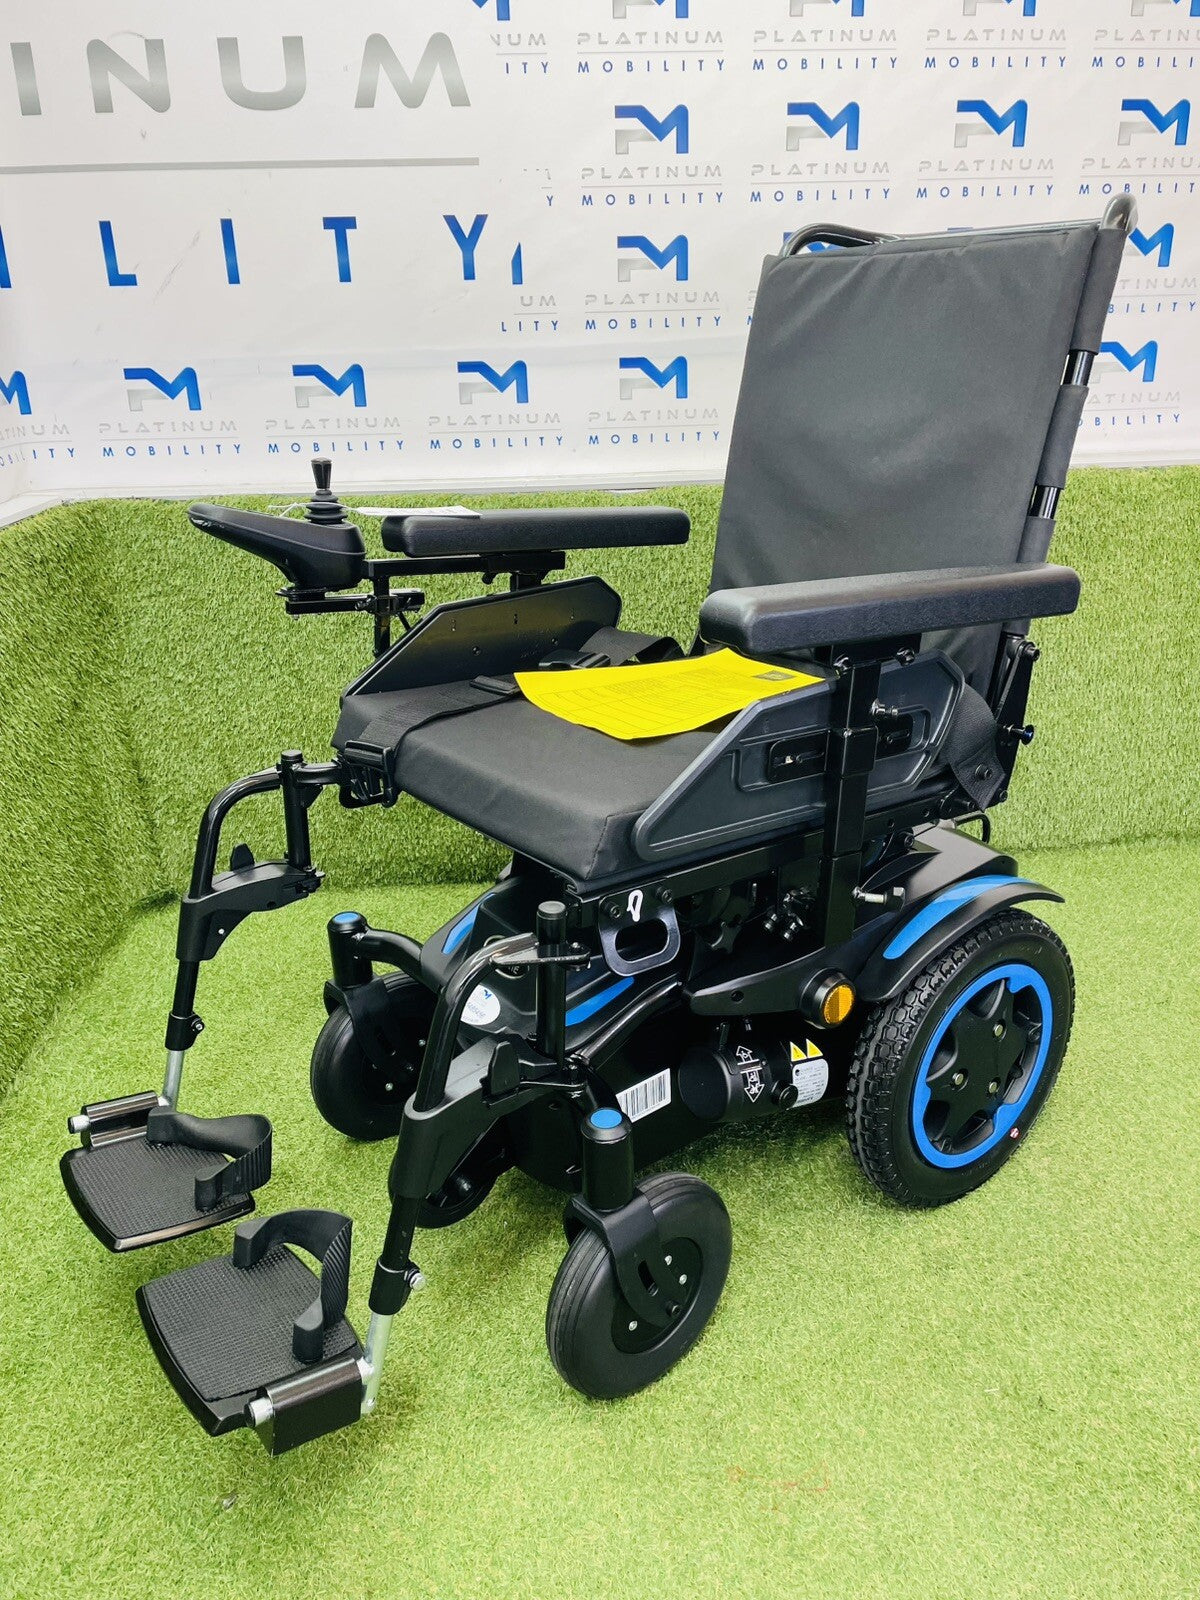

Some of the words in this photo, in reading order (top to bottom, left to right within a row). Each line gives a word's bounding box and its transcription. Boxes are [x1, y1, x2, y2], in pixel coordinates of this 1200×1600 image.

[577, 31, 723, 45] PLATINUM
[754, 29, 896, 43] PLATINUM
[927, 29, 1066, 41] PLATINUM
[578, 59, 724, 73] MOBILITY
[753, 57, 897, 70] MOBILITY
[925, 56, 1065, 68] MOBILITY
[751, 162, 889, 176] PLATINUM
[919, 159, 1054, 172] PLATINUM
[582, 165, 721, 180] PLATINUM
[750, 188, 889, 202] MOBILITY
[916, 185, 1053, 198] MOBILITY
[582, 192, 722, 205] MOBILITY
[585, 291, 720, 305] PLATINUM
[585, 316, 720, 329] MOBILITY
[429, 413, 560, 426] PLATINUM
[588, 408, 719, 423] PLATINUM
[99, 421, 237, 433] PLATINUM
[266, 417, 400, 430] PLATINUM
[430, 436, 562, 449] MOBILITY
[589, 431, 719, 444] MOBILITY
[103, 444, 240, 457] MOBILITY
[268, 440, 403, 453] MOBILITY
